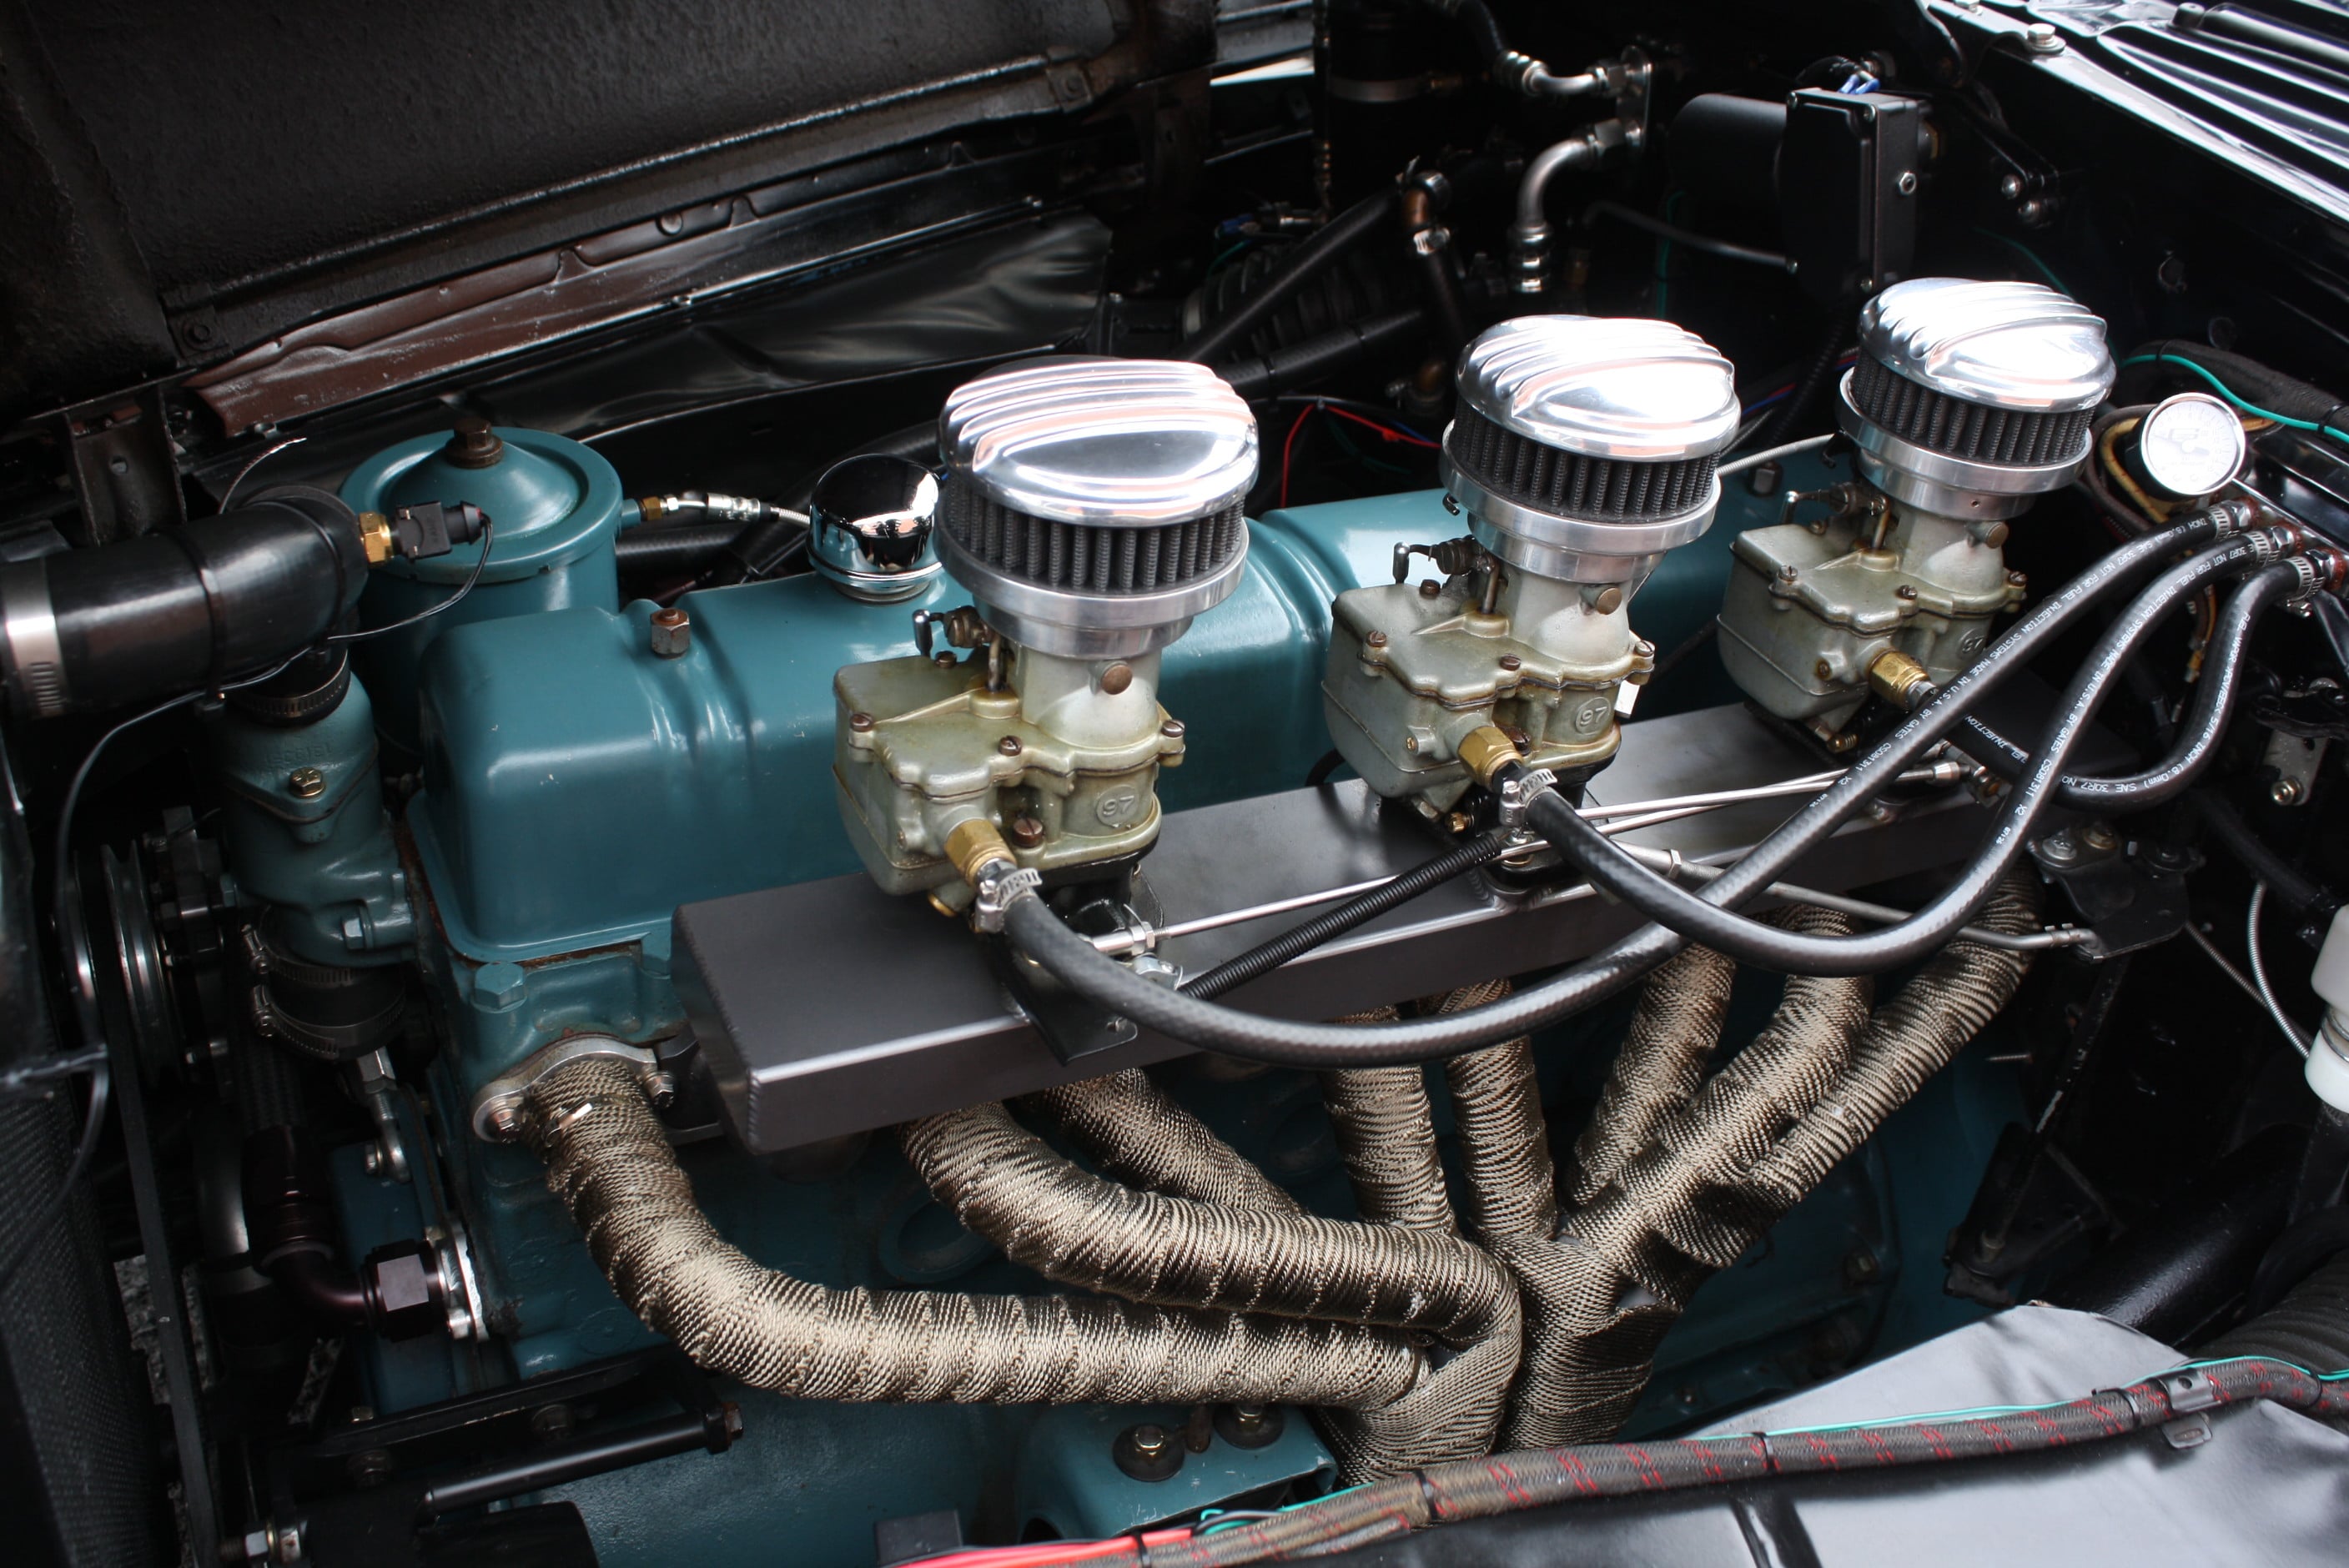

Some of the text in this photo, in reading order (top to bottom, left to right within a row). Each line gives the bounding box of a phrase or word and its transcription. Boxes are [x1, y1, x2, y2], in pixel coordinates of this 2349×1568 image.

[2187, 517, 2208, 530] INCH
[2136, 540, 2153, 553] SAE
[2100, 562, 2116, 576] NOT
[2196, 560, 2212, 575] FOR
[2213, 553, 2227, 566] NOT
[2081, 573, 2100, 588] FOR
[2175, 570, 2196, 586] FUEL
[2060, 585, 2083, 601] FUEL
[2140, 585, 2178, 621] INJECTION
[2020, 601, 2063, 634] INJECTION
[2236, 611, 2251, 631] FUEL
[2116, 619, 2143, 651] SYSTEMS
[1989, 632, 2022, 660] SYSTEMS
[2229, 636, 2242, 663] VAPOR
[1969, 658, 1991, 676] MADE
[2100, 648, 2120, 671] MADE
[1957, 676, 1971, 686] IN
[2092, 671, 2104, 683] IN
[1931, 686, 1960, 706] U.S.A.
[2074, 682, 2096, 709] U.S.A.
[1579, 706, 1608, 726] 97
[1919, 708, 1933, 720] BY
[2066, 713, 2078, 726] BY
[1894, 719, 1920, 740] GATES
[1964, 715, 2008, 749] INJECTION
[2202, 716, 2219, 740] 5/16
[2050, 726, 2070, 754] GATES
[2184, 741, 2206, 764] INCH
[2061, 776, 2077, 787] NO
[2143, 763, 2184, 789] (8.0mm)
[2115, 782, 2137, 793] SAE
[1102, 795, 1135, 817] 97
